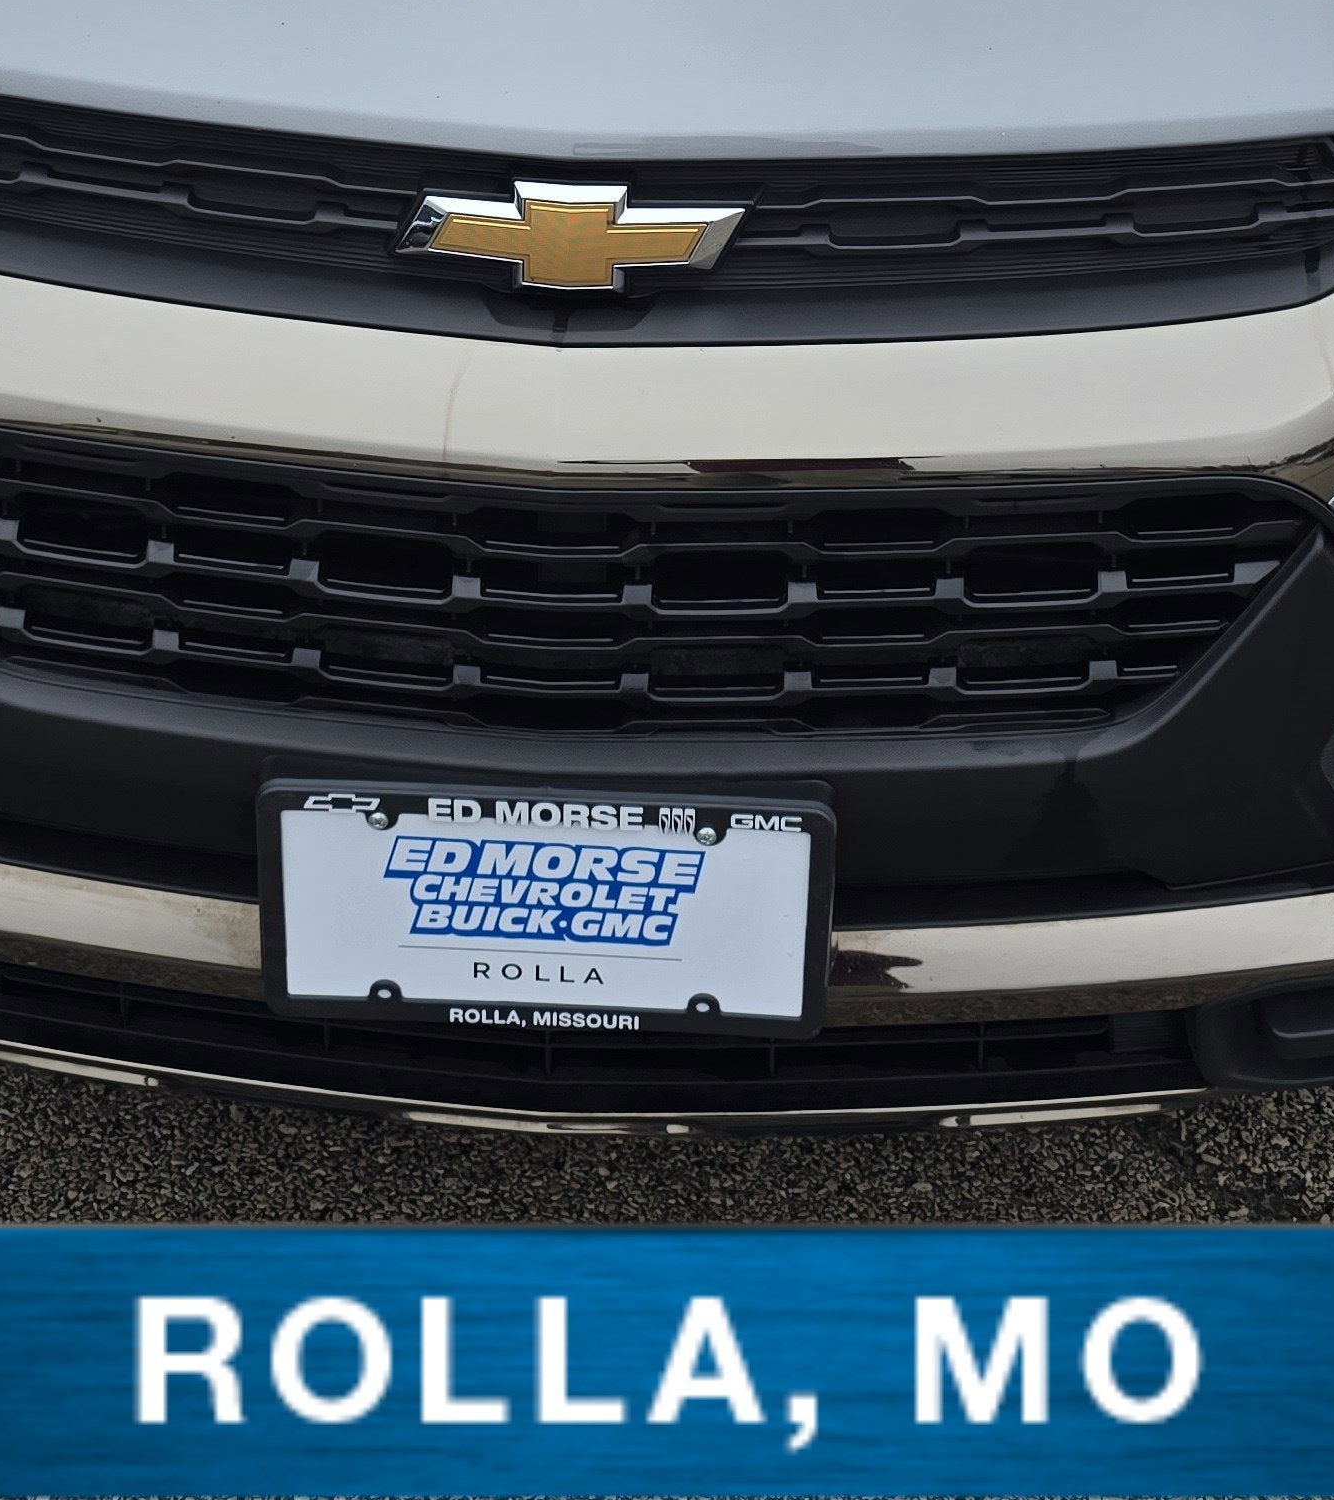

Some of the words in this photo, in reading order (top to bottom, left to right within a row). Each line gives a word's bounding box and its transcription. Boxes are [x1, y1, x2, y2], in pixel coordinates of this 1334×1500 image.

[427, 798, 483, 823] ED
[495, 800, 644, 831] MORSE
[730, 813, 803, 832] GMC
[388, 838, 472, 874] ED
[476, 842, 702, 886] MORSE
[412, 874, 677, 912] CHEVROLET
[472, 961, 605, 985] ROLLA
[448, 1007, 527, 1028] ROLLA,
[532, 1010, 640, 1031] MISSOURI
